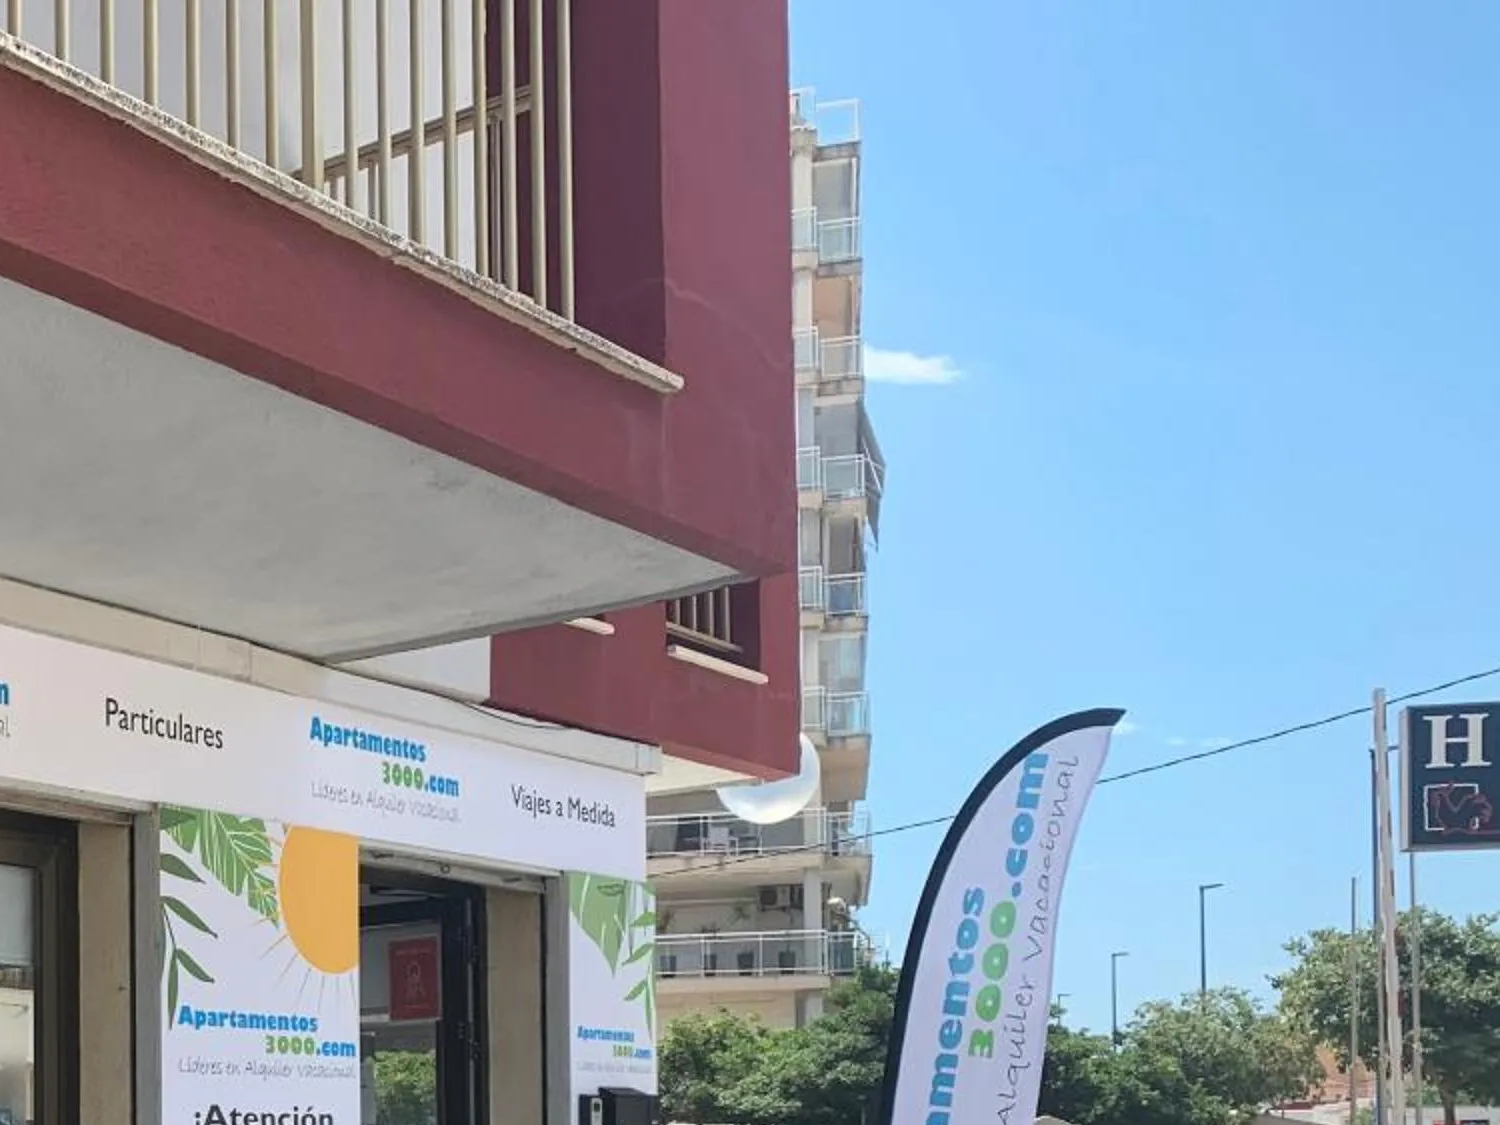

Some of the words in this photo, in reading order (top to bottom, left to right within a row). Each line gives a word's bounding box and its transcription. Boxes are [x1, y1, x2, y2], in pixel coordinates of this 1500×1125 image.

[105, 697, 224, 750] Particulares
[309, 715, 427, 764] Apartamentos
[1422, 713, 1493, 769] H
[381, 760, 460, 797] 3000.com
[510, 784, 552, 819] Viajes
[555, 798, 564, 817] a
[567, 796, 616, 828] Medida
[1022, 755, 1079, 963] Vacacional
[968, 752, 1049, 1059] 3000.com
[177, 1004, 319, 1032] Apartamentos
[264, 1034, 357, 1058] 3000.com
